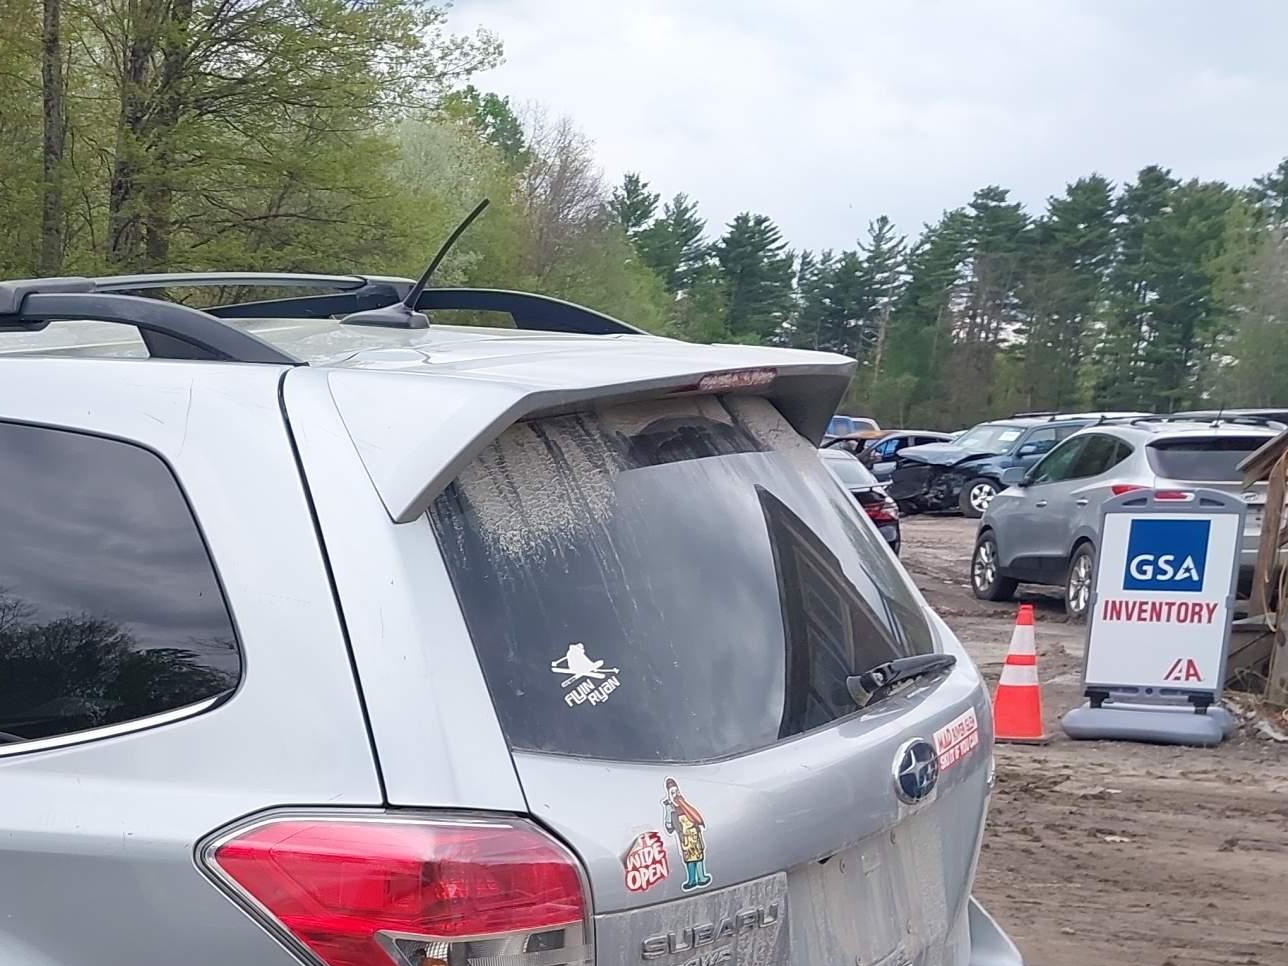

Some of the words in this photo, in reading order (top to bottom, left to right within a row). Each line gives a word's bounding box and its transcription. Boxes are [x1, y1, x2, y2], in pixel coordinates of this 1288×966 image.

[1129, 554, 1200, 582] GSA
[1102, 600, 1219, 624] INVENTORY
[626, 842, 666, 871] WIDE
[626, 858, 669, 891] OPEN
[641, 903, 779, 960] SUBARU
